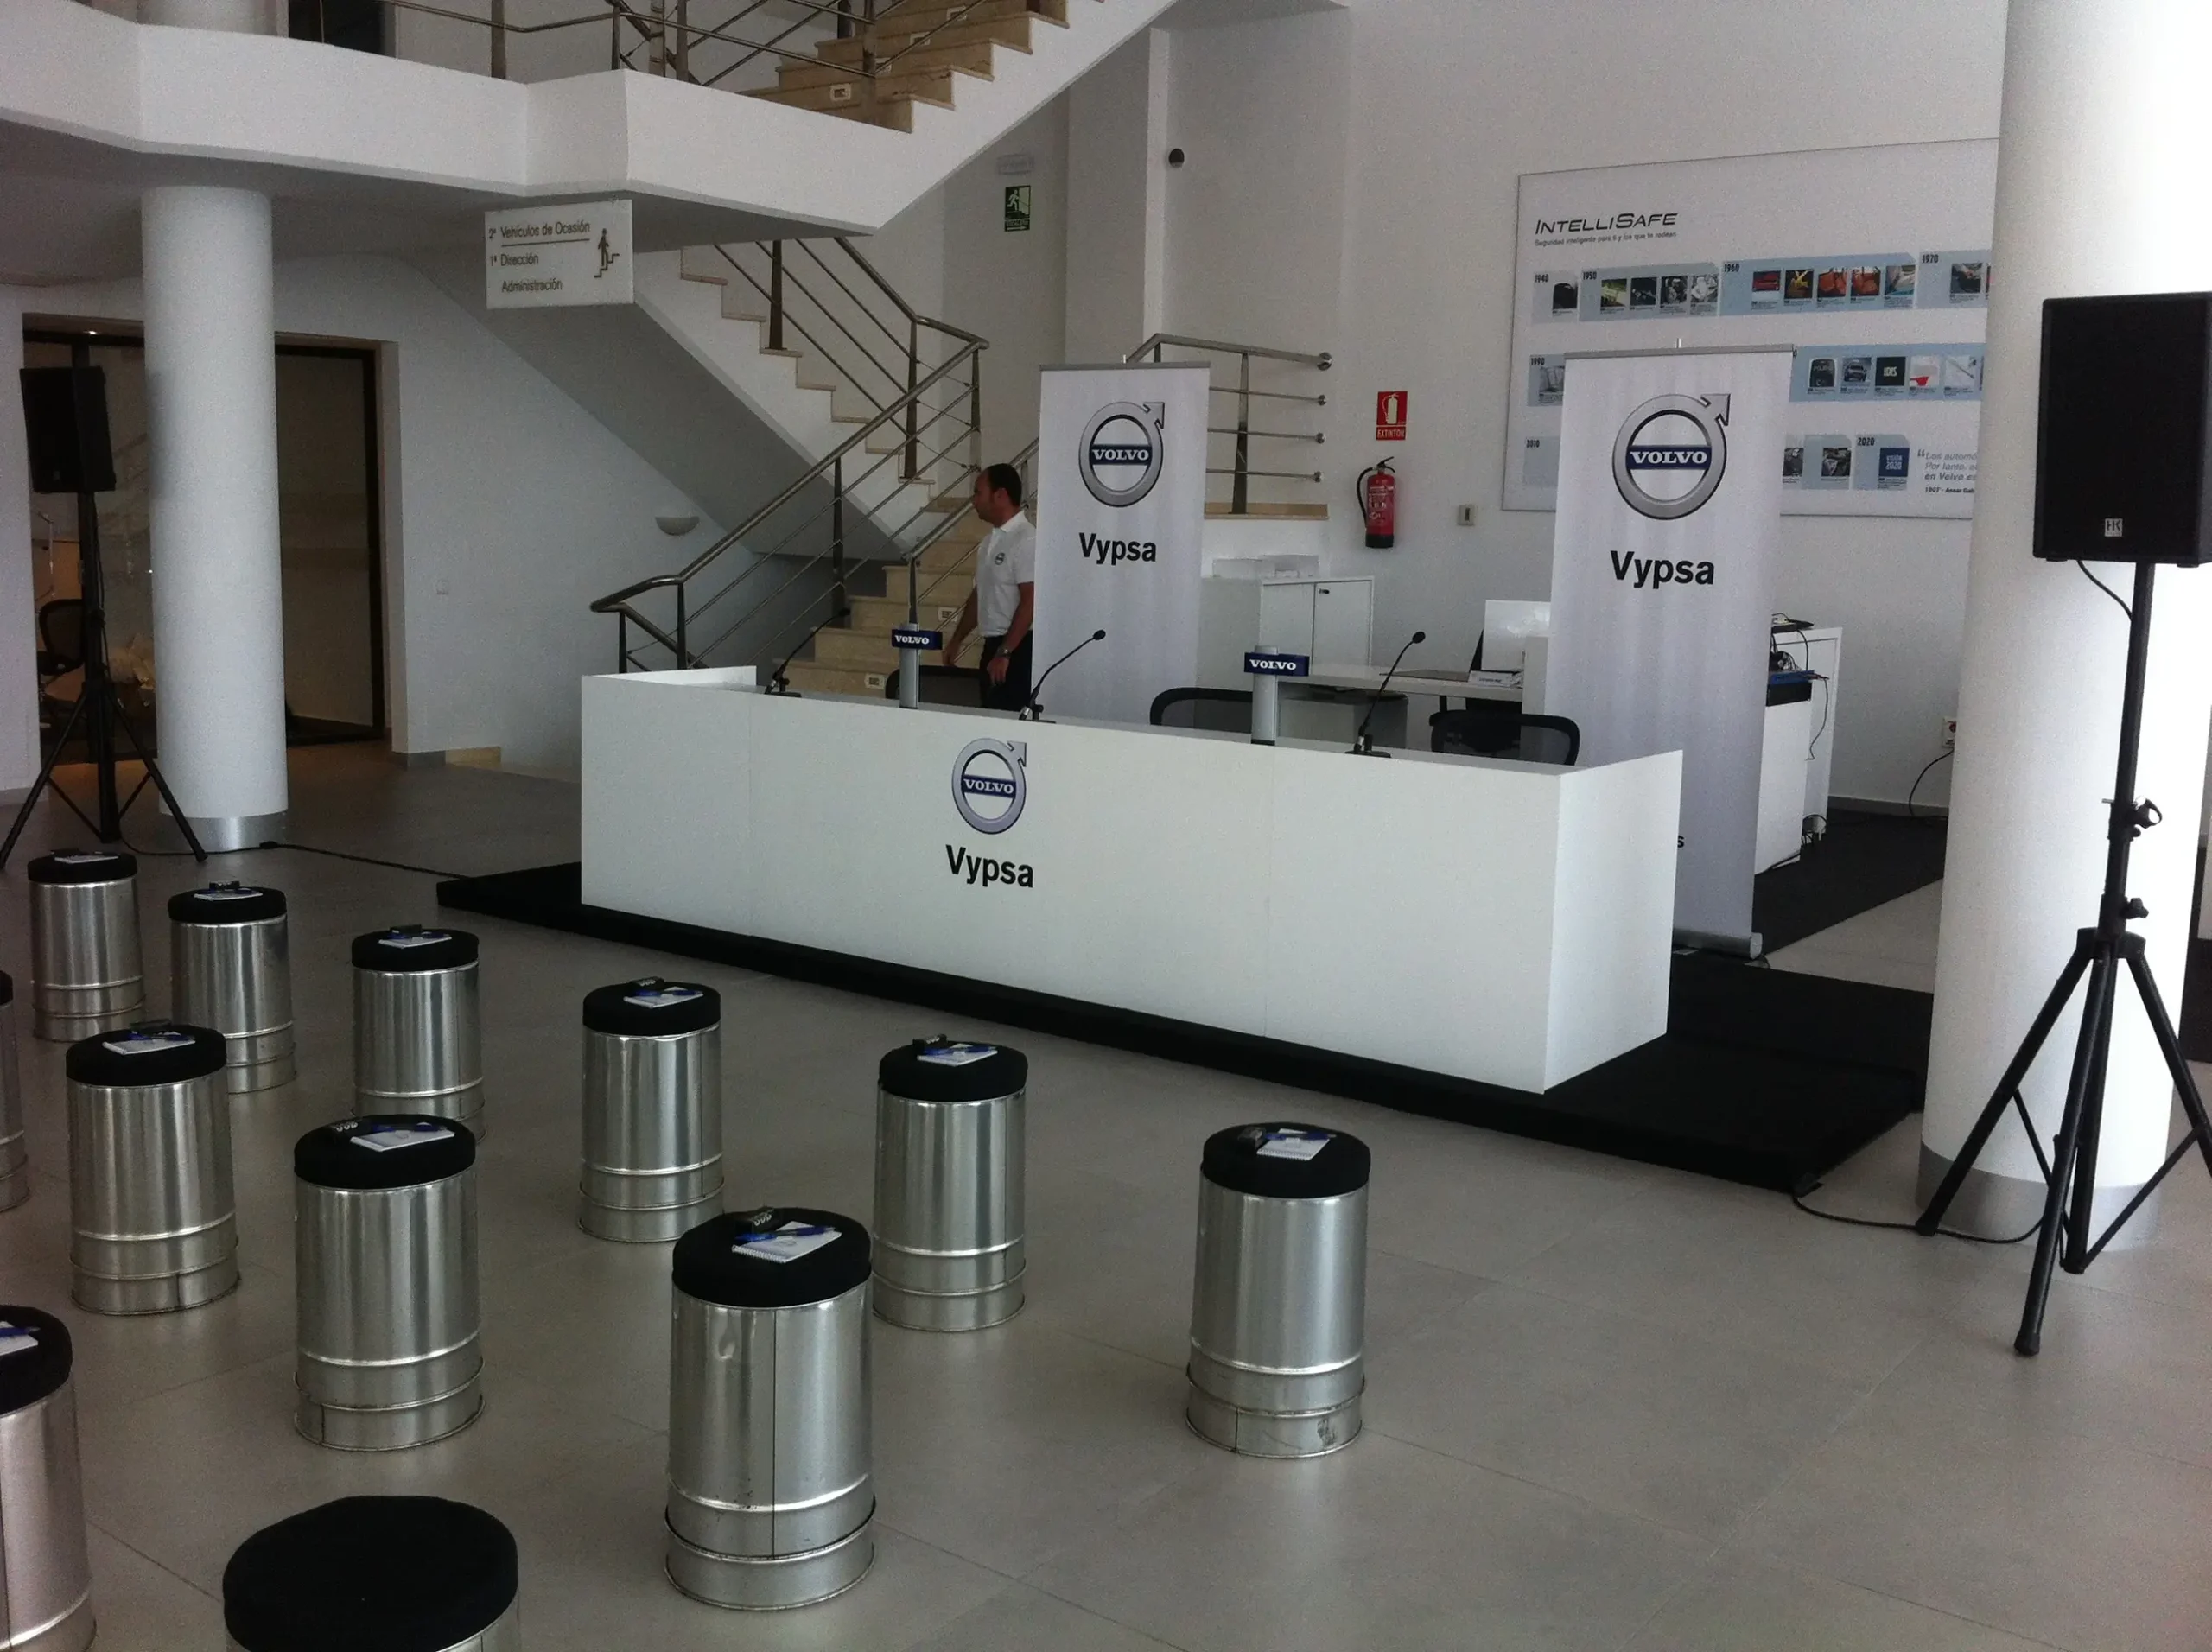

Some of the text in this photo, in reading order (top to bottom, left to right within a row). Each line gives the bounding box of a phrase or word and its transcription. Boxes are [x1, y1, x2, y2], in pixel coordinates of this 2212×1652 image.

[500, 224, 540, 239] Vehículos
[542, 224, 553, 236] de
[555, 219, 591, 235] Ocasión
[1535, 238, 1565, 247] Seguridad
[500, 252, 539, 266] Dirección
[1922, 254, 1939, 264] 1970
[1724, 263, 1740, 272] 1960
[1535, 273, 1549, 283] 1940
[1583, 271, 1597, 280] 1950
[501, 277, 563, 293] Administración
[1857, 437, 1875, 446] 2020
[1092, 449, 1150, 461] VOLVO
[1630, 451, 1707, 464] VOLVO
[1078, 532, 1157, 566] Vypsa
[1610, 550, 1715, 589] Vypsa
[894, 634, 930, 645] VOLVO
[1249, 658, 1297, 670] VOLVO
[963, 778, 1014, 794] VOLVO
[945, 844, 1034, 888] Vypsa
